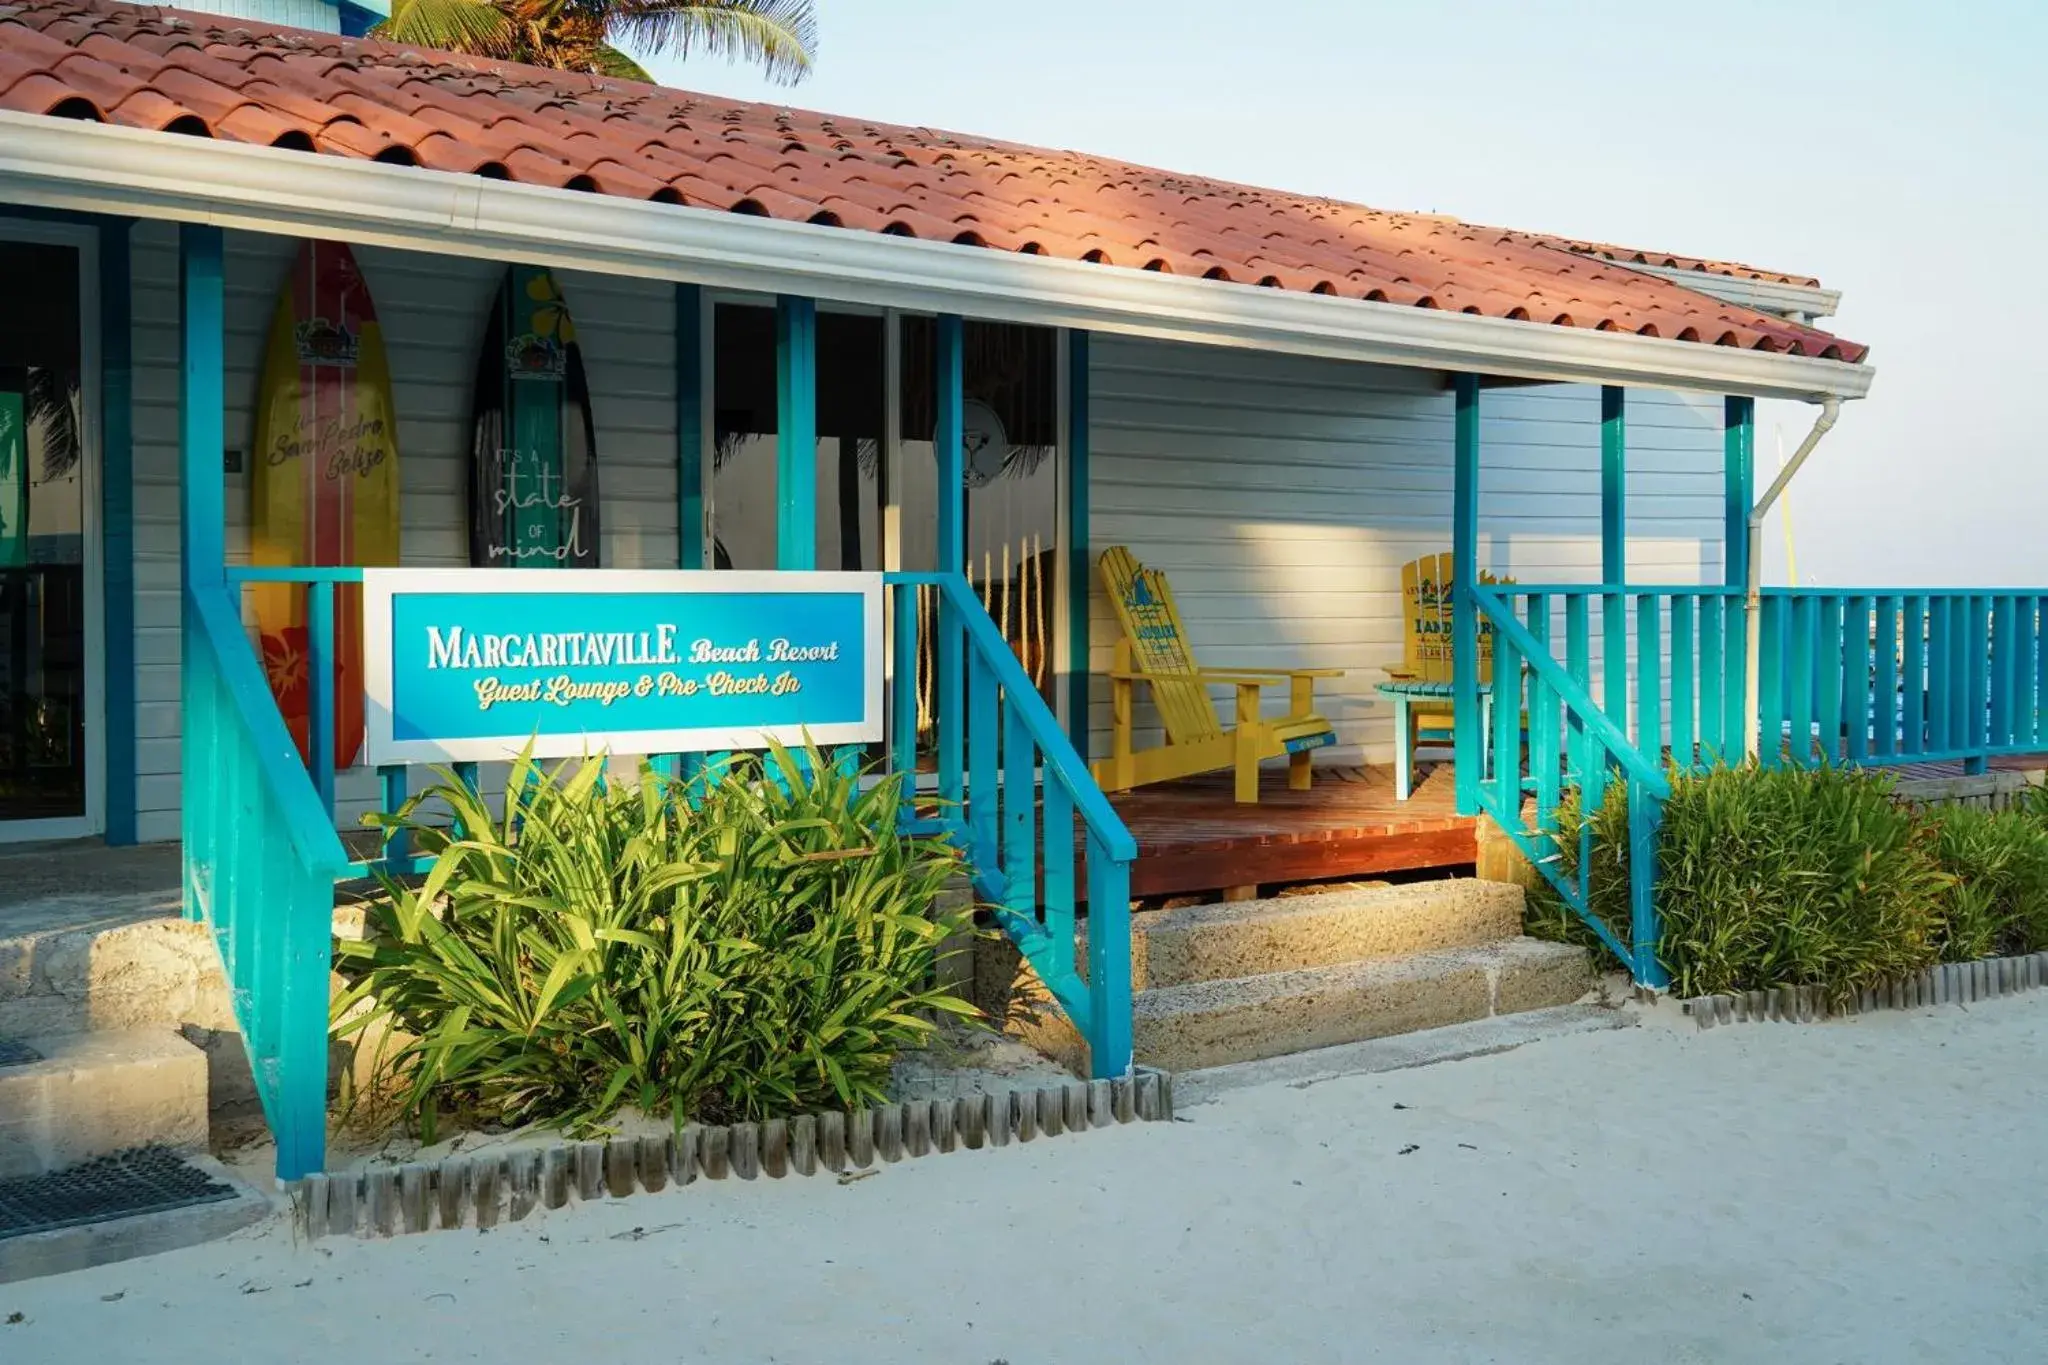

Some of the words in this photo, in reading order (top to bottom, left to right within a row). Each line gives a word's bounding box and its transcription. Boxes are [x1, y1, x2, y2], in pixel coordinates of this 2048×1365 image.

[325, 447, 385, 481] Belize
[530, 448, 540, 463] A
[495, 462, 582, 515] state
[489, 506, 588, 560] mind
[528, 524, 545, 539] OF
[426, 623, 677, 669] MARGARITAVILLE
[688, 637, 761, 664] Beach
[766, 637, 839, 663] Resort
[473, 676, 542, 711] Guest
[543, 674, 631, 706] Lounge
[633, 675, 655, 697] &
[658, 671, 770, 697] Pre-Check
[771, 671, 802, 696] In
